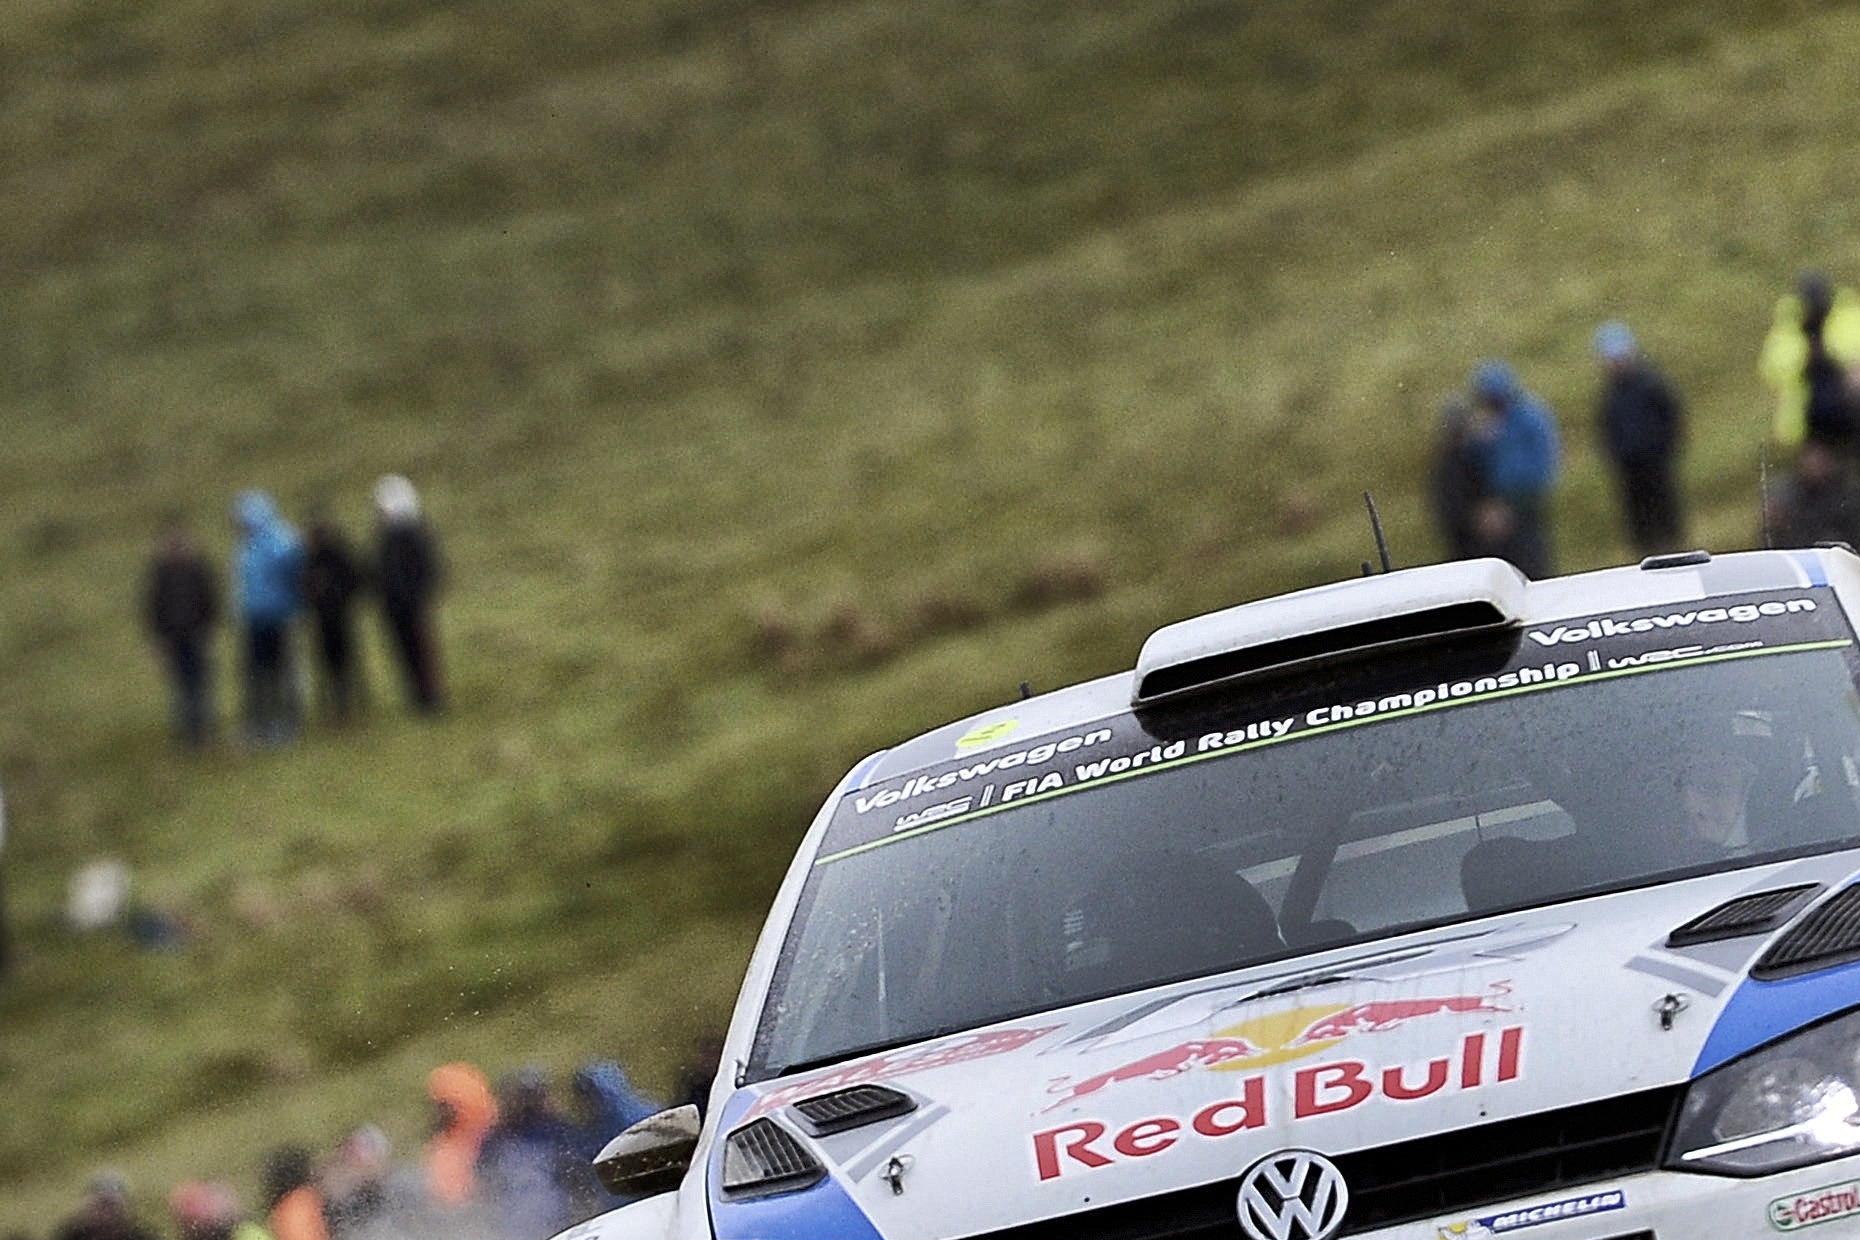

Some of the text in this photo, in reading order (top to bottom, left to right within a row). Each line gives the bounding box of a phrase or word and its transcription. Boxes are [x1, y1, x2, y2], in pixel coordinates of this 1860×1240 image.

[1529, 597, 1817, 646] Volkswagen
[855, 727, 1112, 815] Volkswagen
[1001, 772, 1062, 802] FIA
[1076, 741, 1186, 782] World
[1197, 715, 1294, 752] Rally
[1306, 658, 1580, 725] Championship
[1032, 1027, 1523, 1181] Red Bull
[1493, 1193, 1621, 1230] MICHELIN
